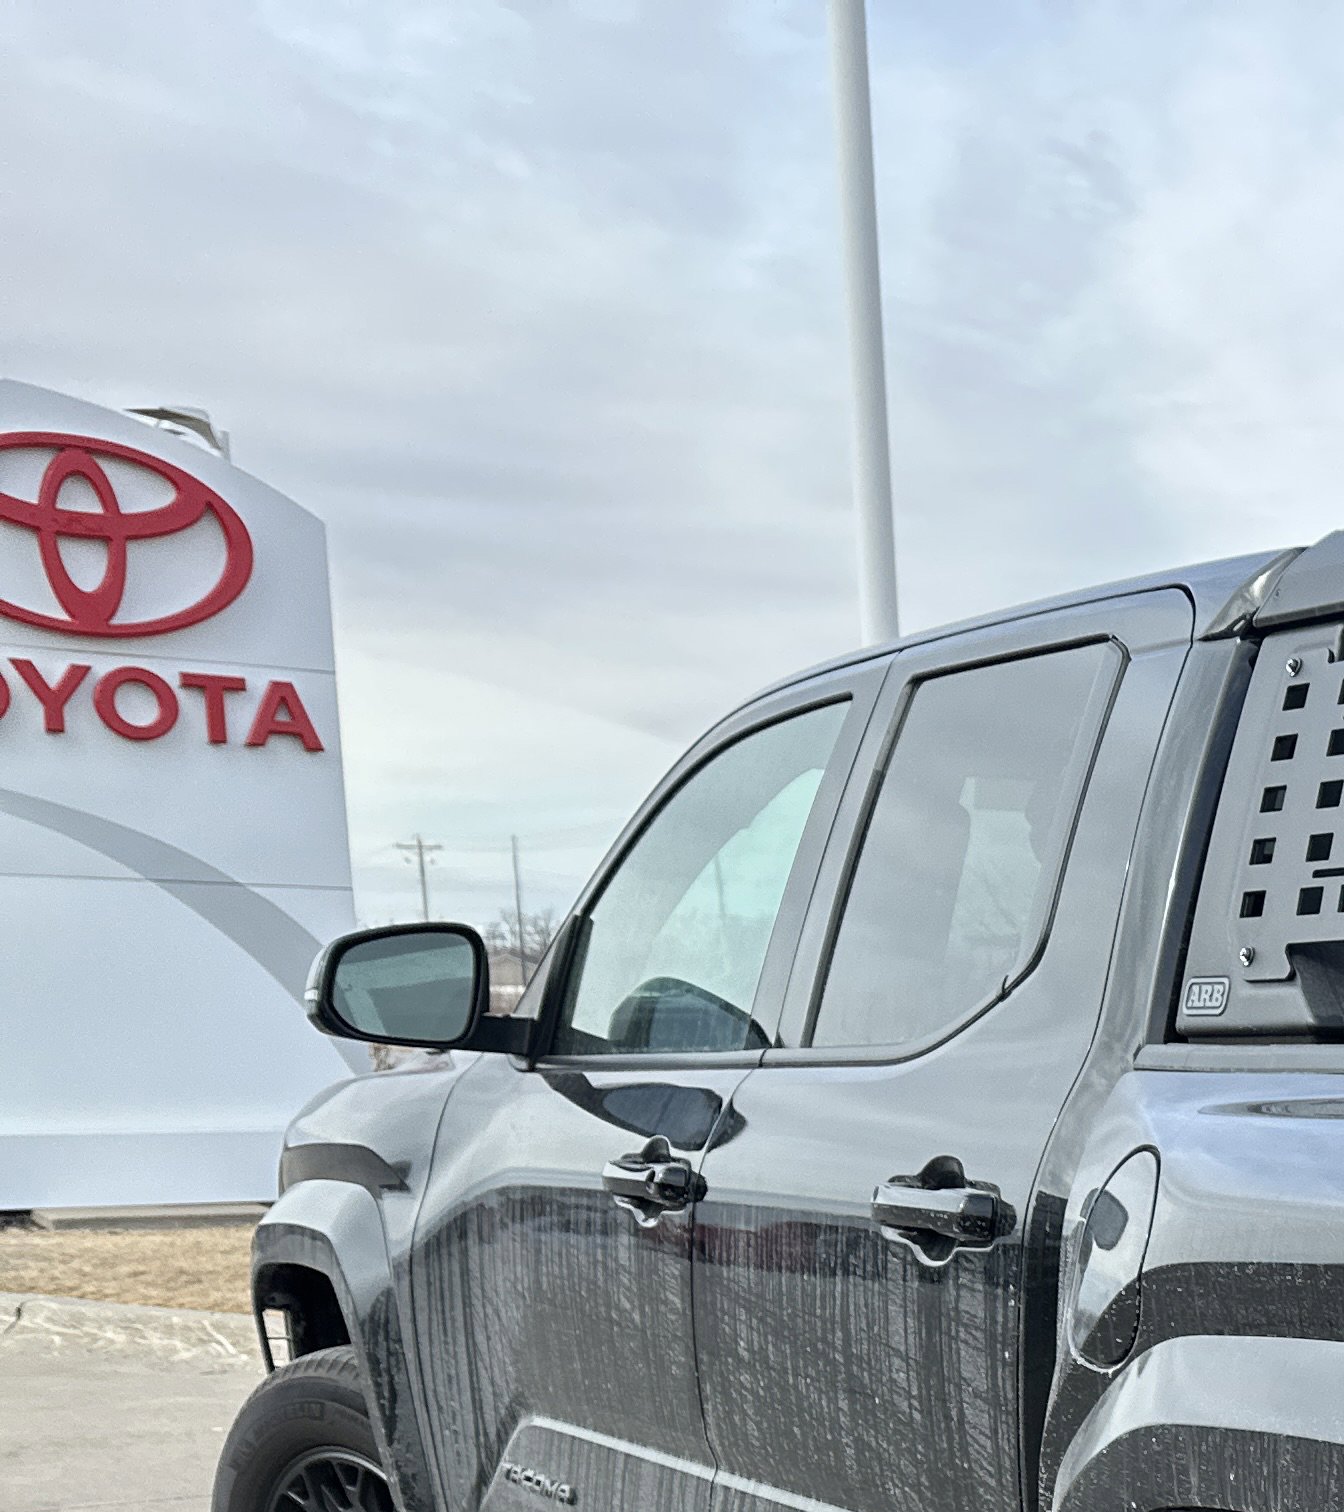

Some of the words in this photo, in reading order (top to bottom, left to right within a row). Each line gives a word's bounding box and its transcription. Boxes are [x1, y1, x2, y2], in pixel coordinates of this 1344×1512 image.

[0, 657, 325, 752] YOTA
[1186, 984, 1225, 1008] ARB
[501, 1460, 572, 1502] TACOMA
